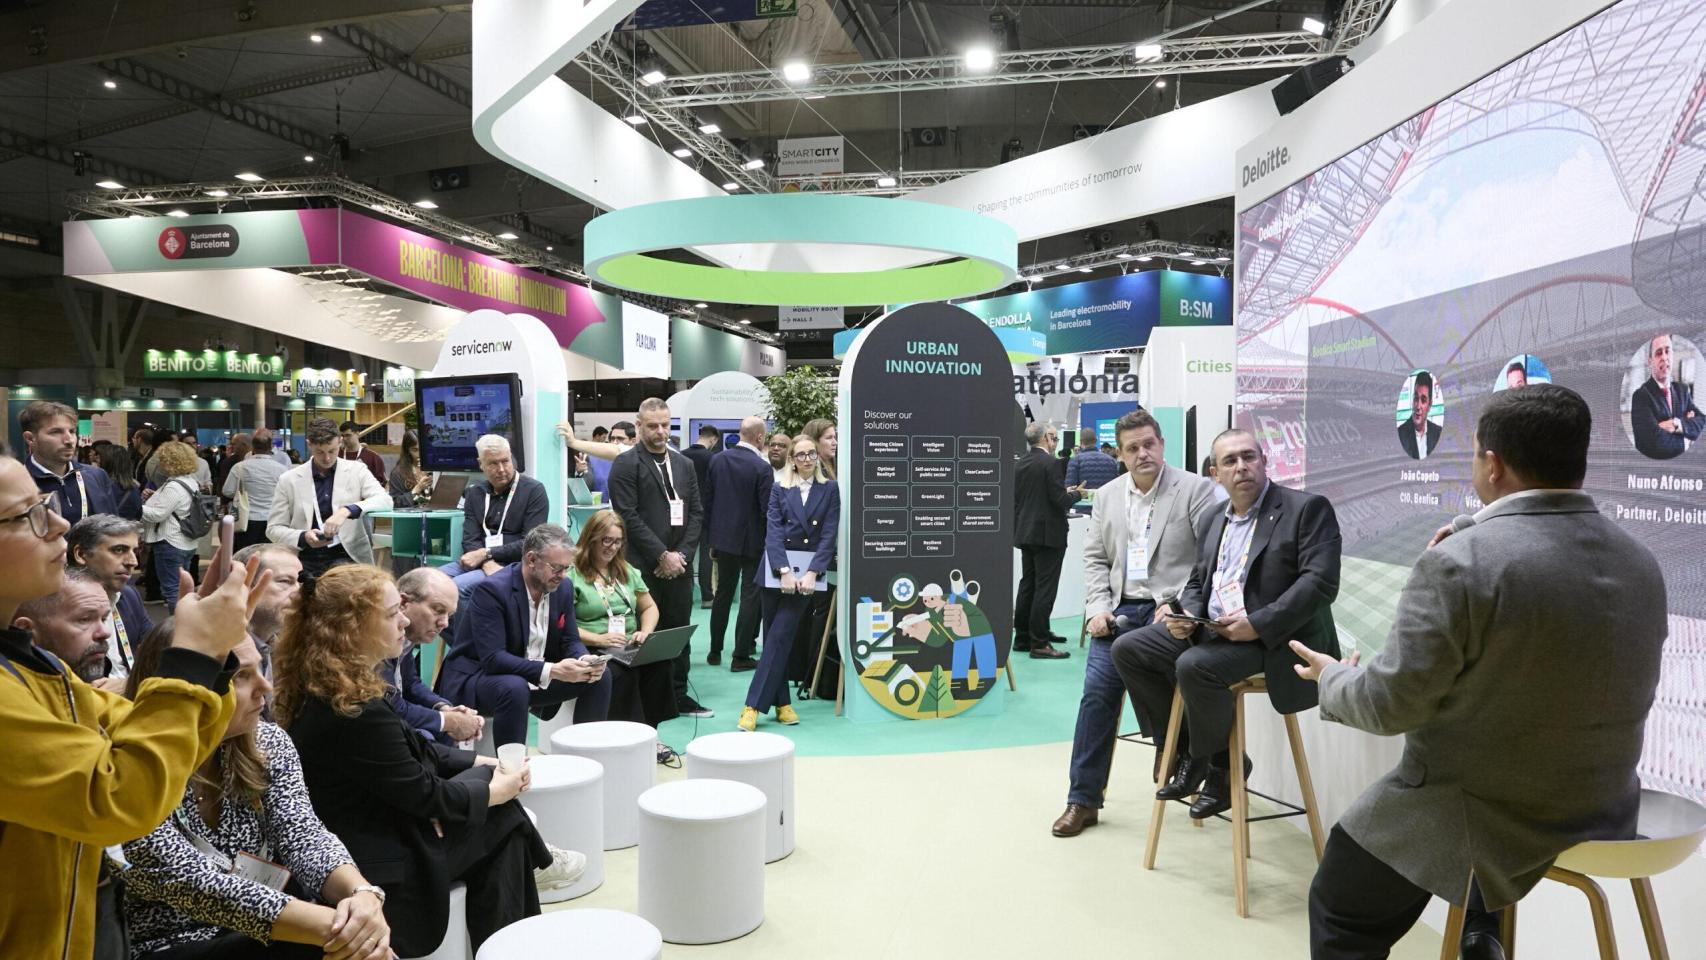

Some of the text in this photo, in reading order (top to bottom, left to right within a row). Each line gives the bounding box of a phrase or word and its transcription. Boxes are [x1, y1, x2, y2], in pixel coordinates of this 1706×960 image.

[1242, 146, 1291, 188] Deloitte.
[977, 162, 1143, 214] Shaping the communities of tomorrow
[190, 240, 230, 249] Barcelona
[400, 239, 566, 316] BARCELONA: BREATHING INNOVATION
[1050, 300, 1132, 318] Leading electromobility
[1180, 298, 1212, 319] B:SM
[990, 312, 1032, 328] ENDOLLA
[1050, 318, 1092, 330] in Barcelona
[452, 340, 512, 356] servicenow
[636, 332, 657, 352] PLA CLIMA
[906, 341, 958, 356] URBAN
[149, 358, 205, 372] BENITO
[226, 359, 271, 375] BENITO
[886, 360, 982, 376] INNOVATION
[1186, 360, 1232, 373] Cities
[296, 379, 342, 388] MILANO
[1014, 368, 1139, 394] atalonia
[864, 410, 898, 419] Discover
[864, 421, 899, 430] solutions
[1628, 474, 1703, 491] Nuno Afonso
[1414, 493, 1438, 505] Benfica
[1465, 496, 1480, 508] Vice
[1617, 504, 1706, 524] Partner, Deloitt
